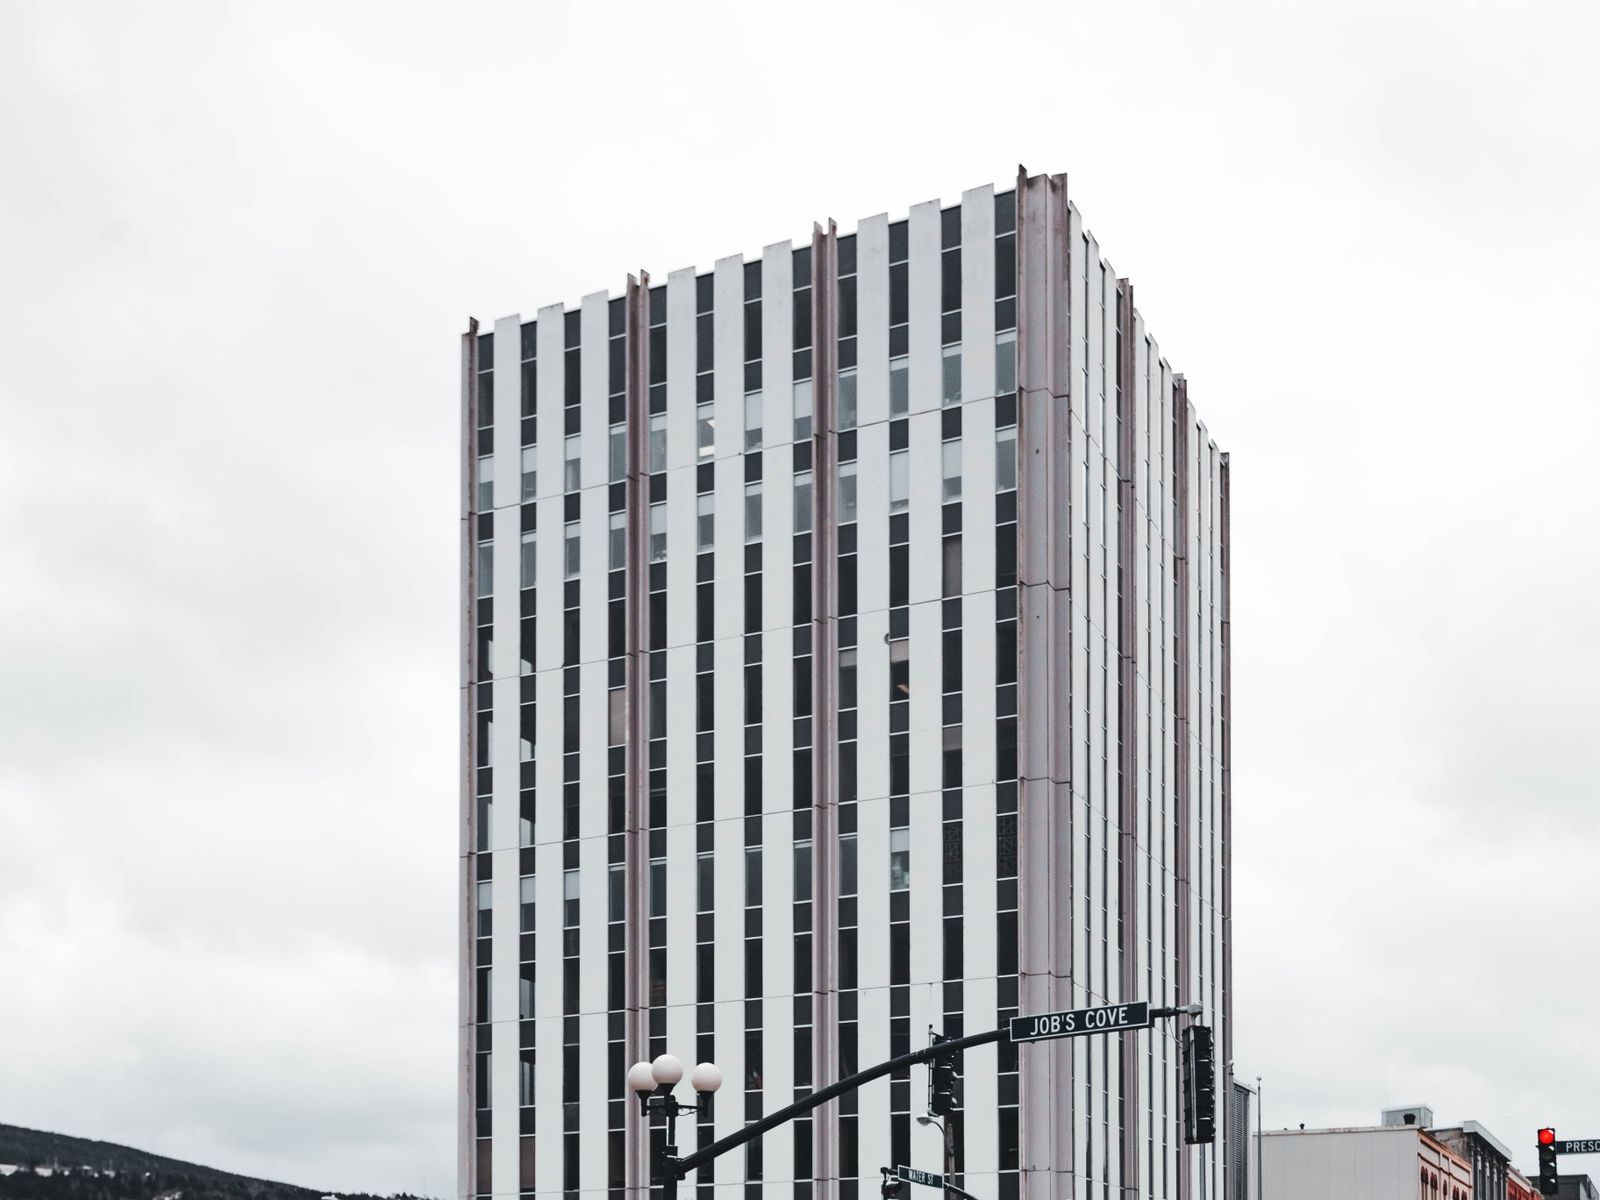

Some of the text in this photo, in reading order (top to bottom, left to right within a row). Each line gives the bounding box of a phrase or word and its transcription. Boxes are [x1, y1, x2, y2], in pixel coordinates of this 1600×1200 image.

[1030, 1007, 1128, 1036] JOB'S COVE
[1566, 1141, 1600, 1152] PRESC
[909, 1170, 934, 1185] WATER ST
